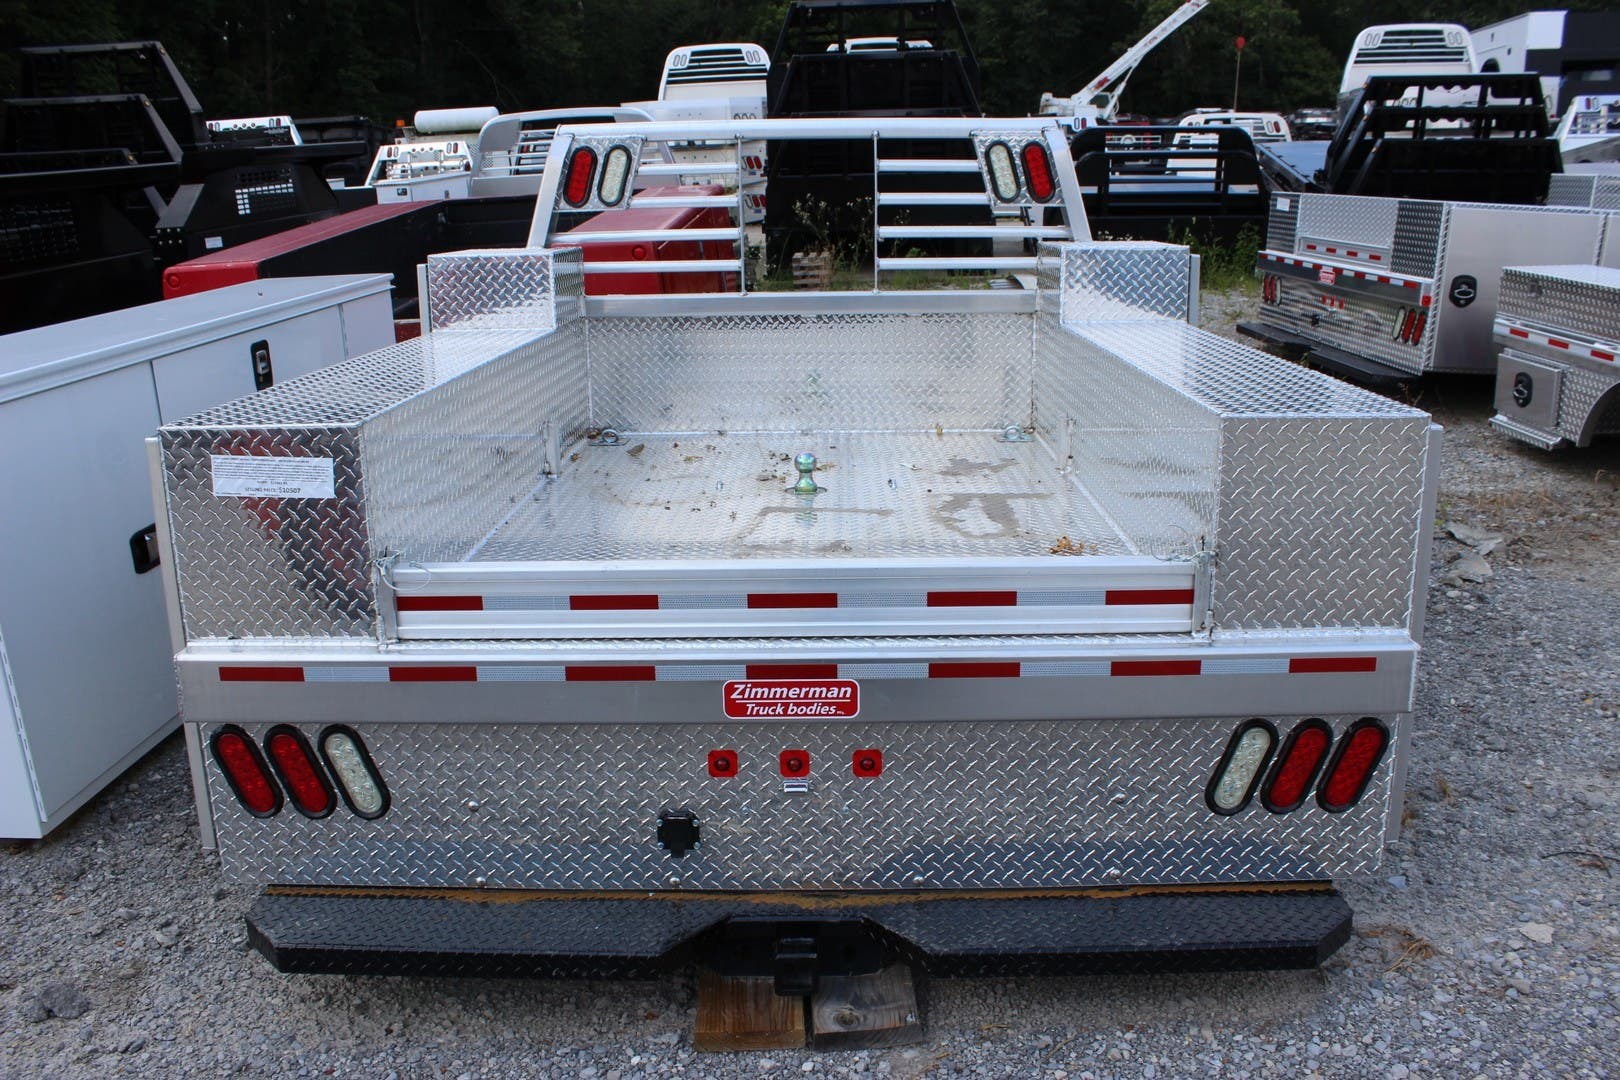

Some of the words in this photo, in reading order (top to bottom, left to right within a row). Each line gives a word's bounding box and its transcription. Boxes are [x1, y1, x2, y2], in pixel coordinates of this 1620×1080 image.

[730, 684, 852, 699] Zimmerman
[746, 703, 784, 715] Truck
[787, 703, 836, 715] bodies
